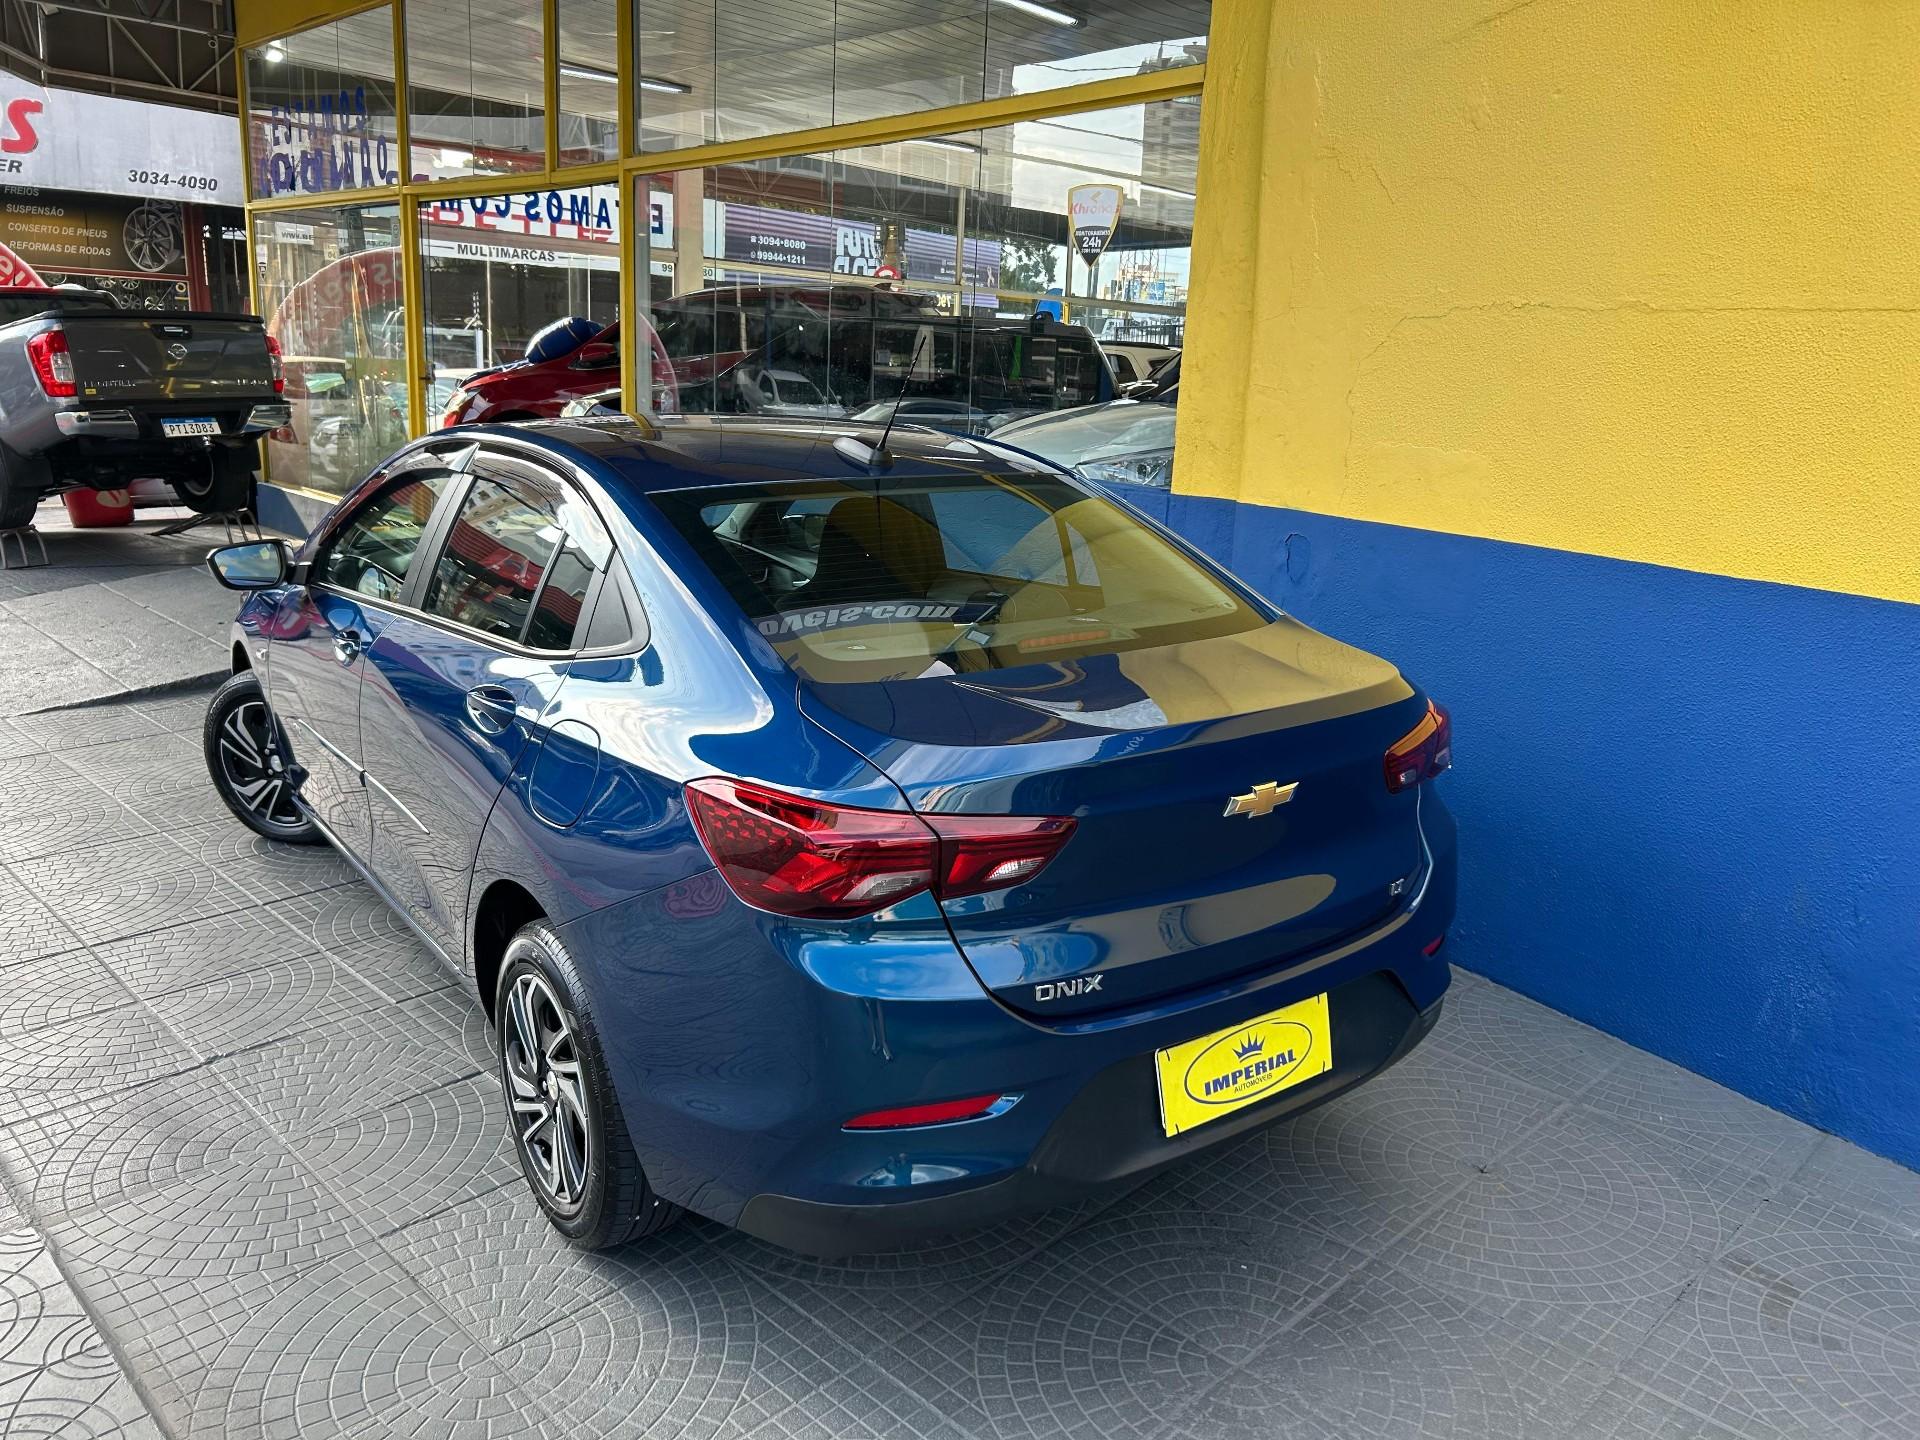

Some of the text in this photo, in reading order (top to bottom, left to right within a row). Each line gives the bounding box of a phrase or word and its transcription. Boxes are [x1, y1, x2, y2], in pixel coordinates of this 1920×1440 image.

[127, 169, 218, 191] 3034-4090
[4, 185, 40, 197] FREIOS
[5, 203, 65, 217] SUSPENSÃO
[7, 222, 108, 239] CONSERTO DE PNEUS
[9, 240, 112, 257] REFORMAS DE RODAS
[1082, 236, 1102, 249] 24h
[457, 243, 556, 263] MULTIMARCAS
[1034, 973, 1104, 1002] ONIX
[1204, 1049, 1297, 1096] IMPERIAL
